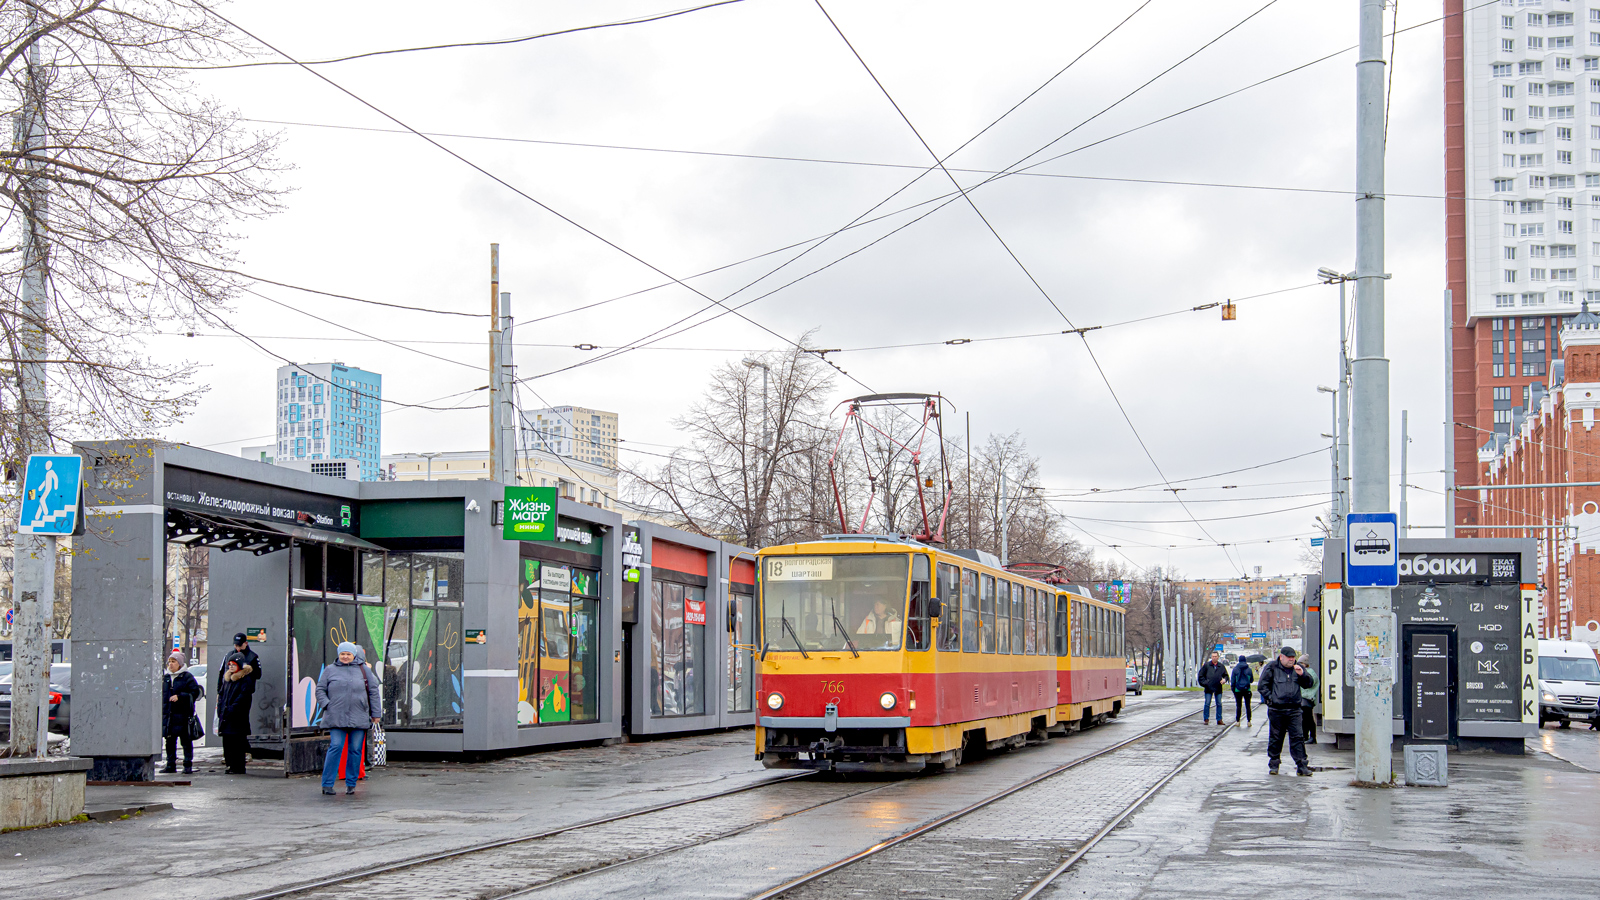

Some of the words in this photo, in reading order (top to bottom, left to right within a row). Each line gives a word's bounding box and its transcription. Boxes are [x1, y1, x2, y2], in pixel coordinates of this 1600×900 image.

[166, 491, 196, 503] ОСТАНОВКА
[509, 498, 551, 511] Жизнь
[316, 514, 334, 526] Station
[512, 511, 547, 523] март
[769, 561, 783, 577] 18
[1398, 554, 1477, 576] абаки
[1494, 603, 1509, 611] city
[1327, 609, 1339, 700] VAPE
[1523, 597, 1536, 717] ТАБАК
[820, 680, 845, 694] 766
